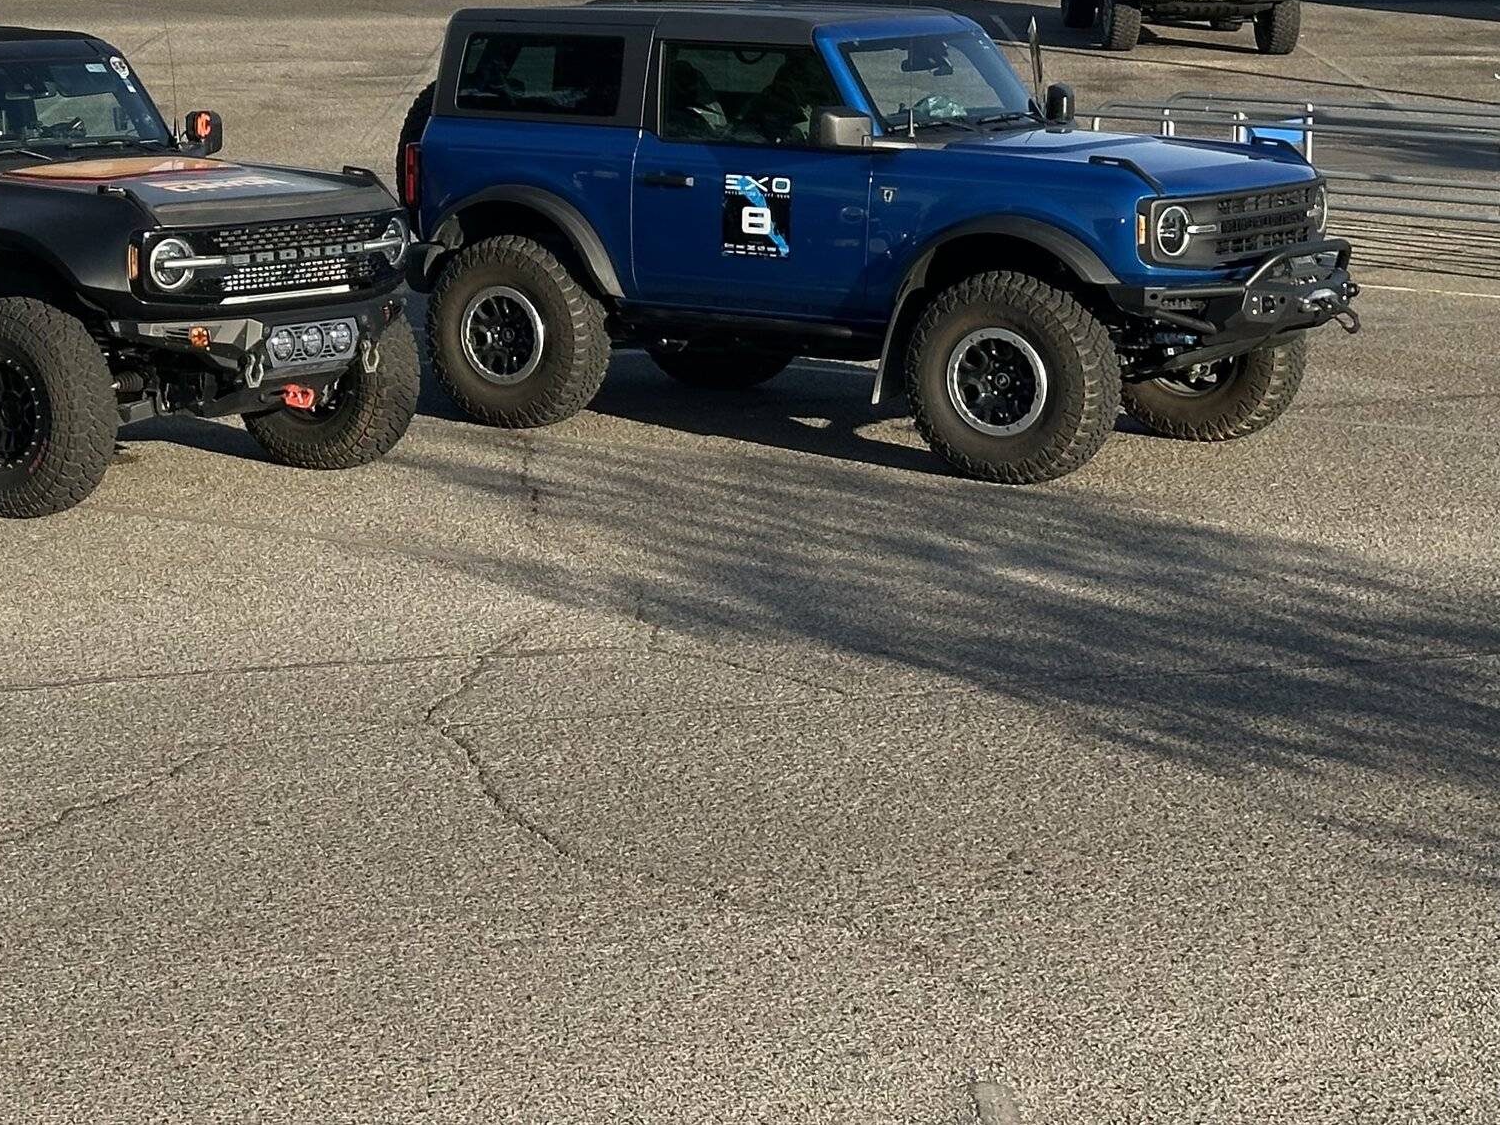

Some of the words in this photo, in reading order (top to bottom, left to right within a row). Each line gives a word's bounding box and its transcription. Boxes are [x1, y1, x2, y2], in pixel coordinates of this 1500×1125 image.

[197, 112, 212, 138] KC
[724, 174, 791, 193] EXO
[741, 206, 771, 235] 8
[232, 241, 364, 265] BRONCO
